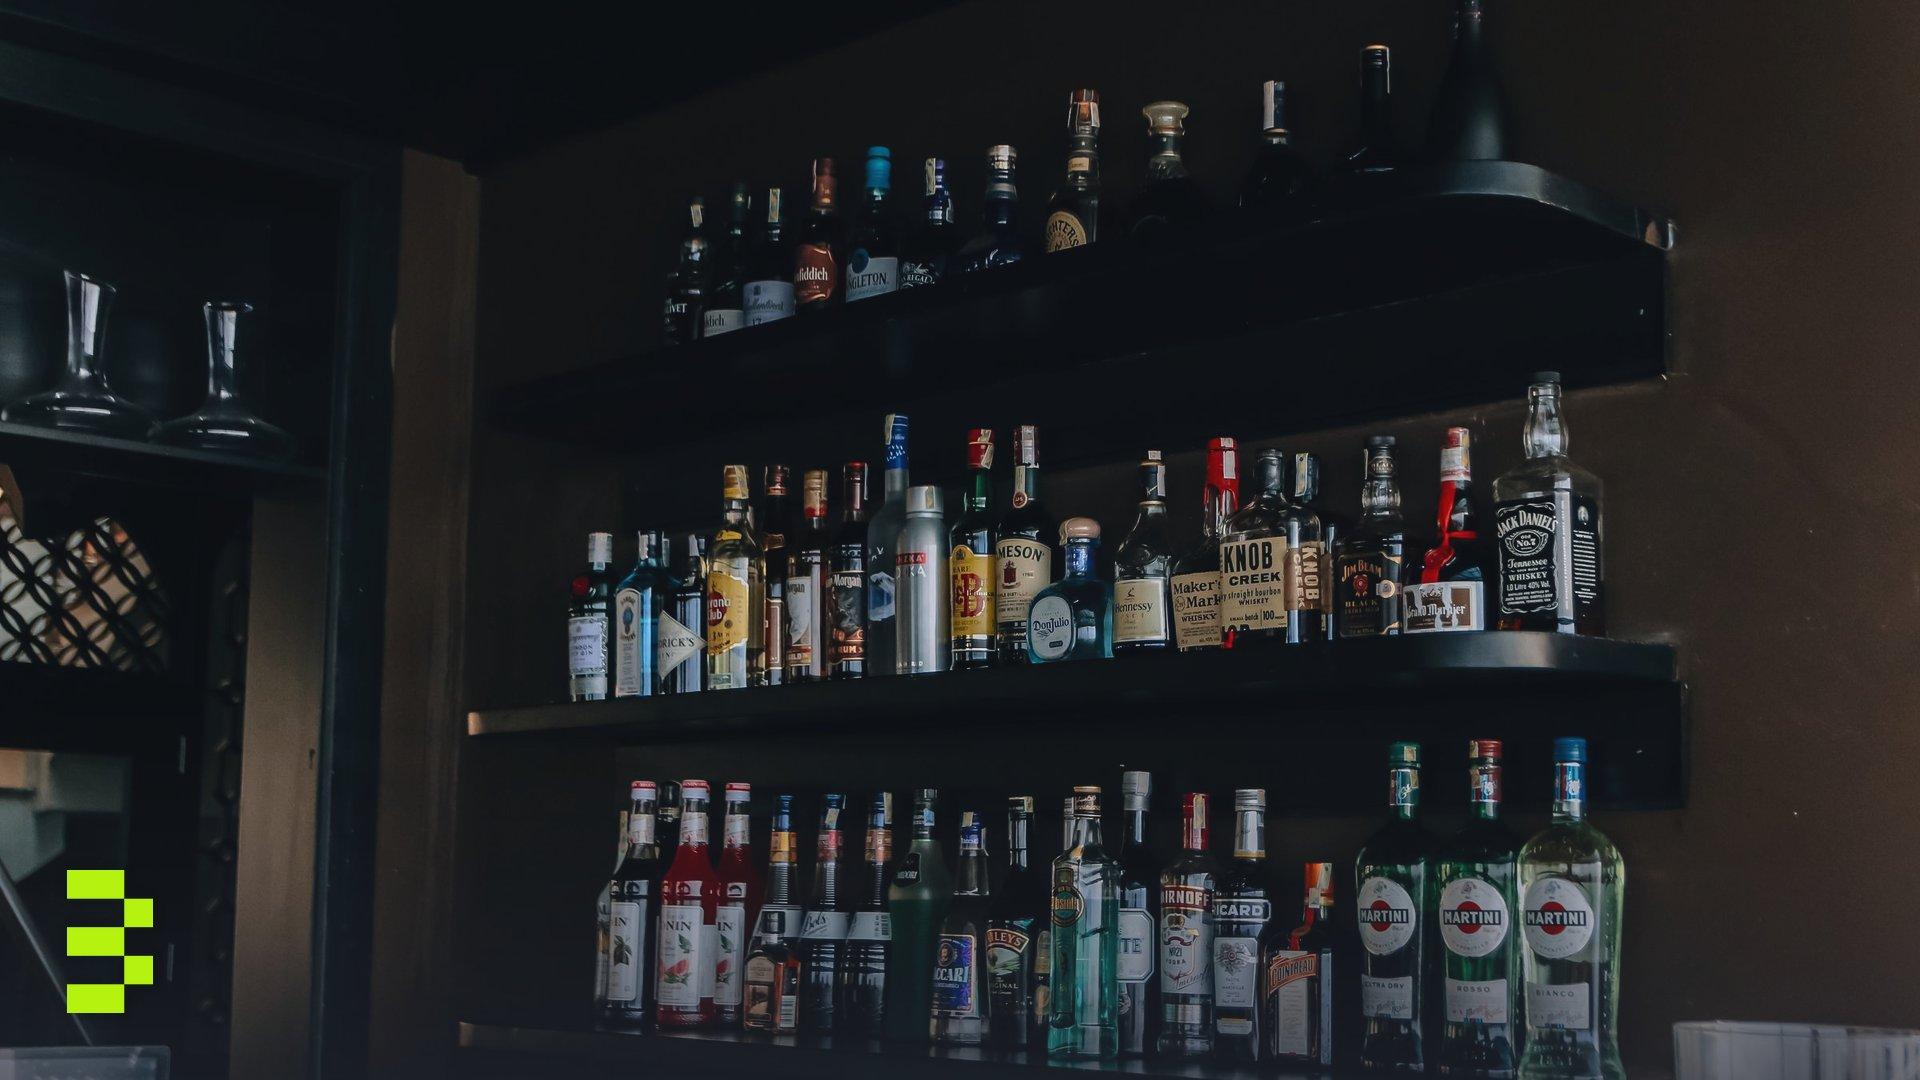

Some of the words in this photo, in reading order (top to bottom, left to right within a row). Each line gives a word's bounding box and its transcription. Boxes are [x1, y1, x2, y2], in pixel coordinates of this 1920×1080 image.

[1497, 515, 1519, 538] JACK
[1519, 510, 1558, 534] DANIEL'S
[998, 545, 1043, 562] MESON
[1224, 541, 1273, 574] KNOB
[1507, 558, 1548, 569] Tennessee
[1301, 546, 1320, 600] KNOB
[1341, 563, 1357, 583] JIM
[1357, 560, 1382, 578] BEAM
[1508, 571, 1548, 581] WHISKEY
[1229, 572, 1281, 586] CREEK
[1228, 588, 1254, 600] straight
[1254, 586, 1282, 597] bourbon
[1114, 601, 1153, 613] Hennessy
[1238, 597, 1269, 606] WHISKEY
[1181, 612, 1217, 622] WHISKY
[1262, 610, 1275, 621] 100
[1360, 909, 1408, 923] MARTINI
[1444, 910, 1500, 925] MARTINI
[1527, 911, 1585, 926] MARTINI
[1457, 985, 1490, 993] ROSSO
[1535, 989, 1575, 998] BIANCO
